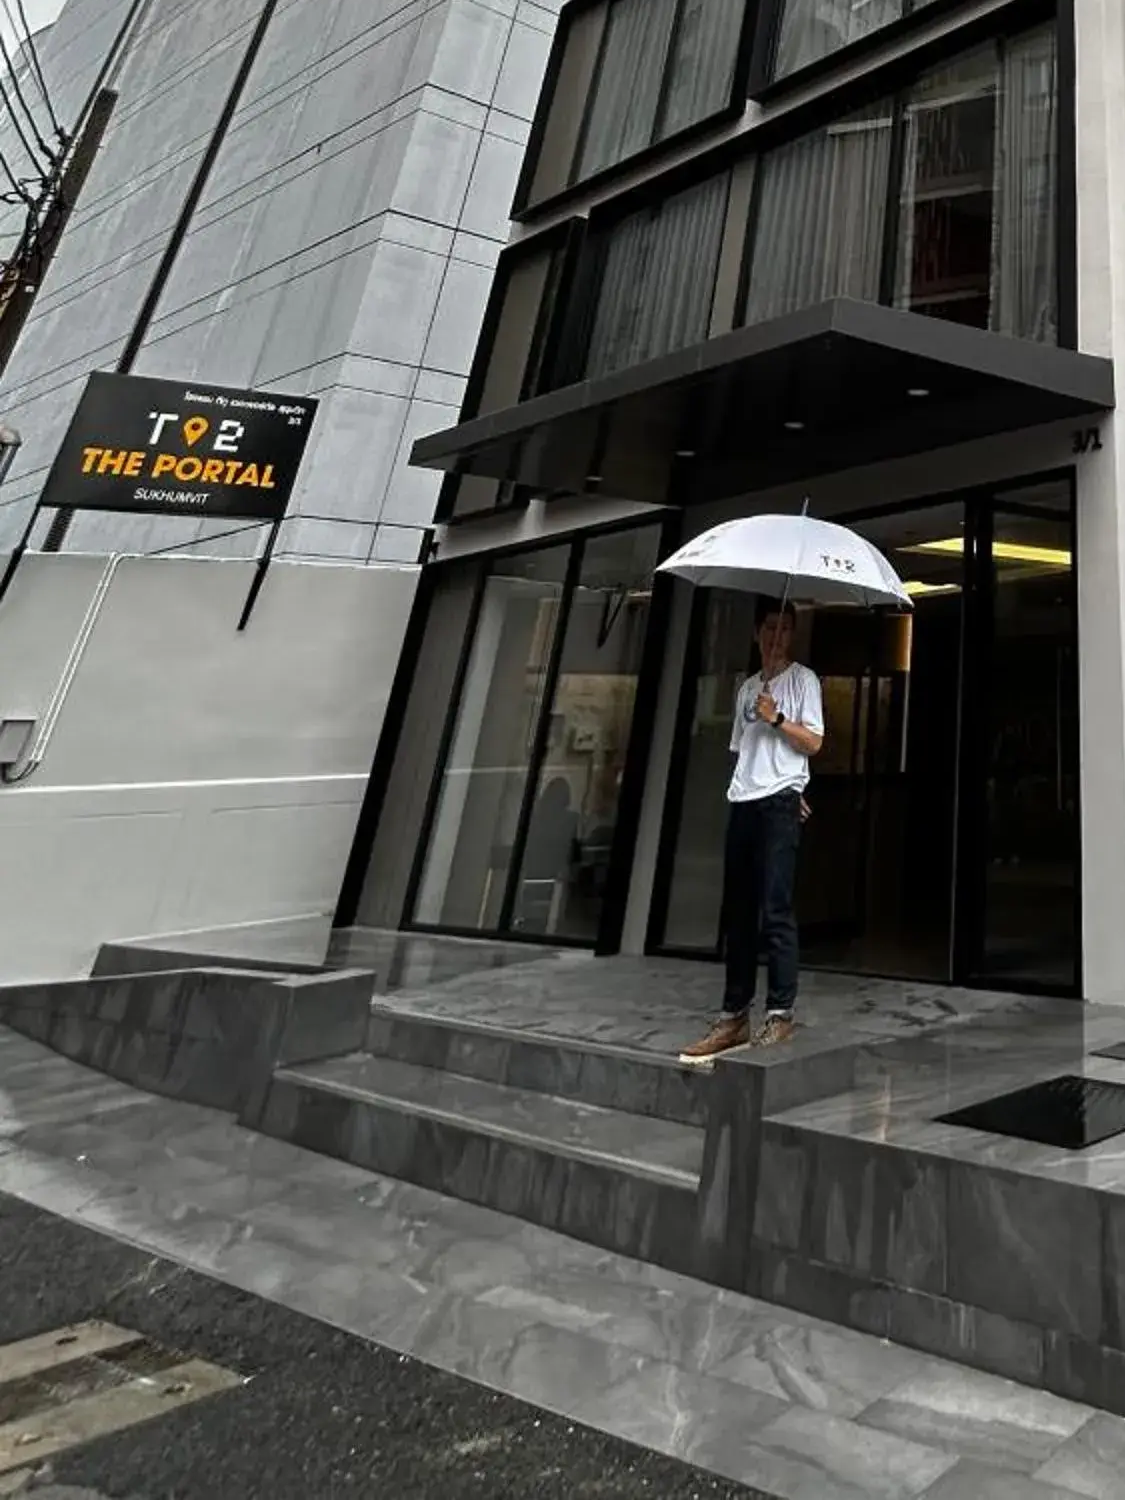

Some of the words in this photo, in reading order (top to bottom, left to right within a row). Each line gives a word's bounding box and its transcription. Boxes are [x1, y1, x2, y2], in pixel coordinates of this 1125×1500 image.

[81, 447, 146, 477] THE
[151, 454, 276, 488] PORTAL
[133, 486, 211, 505] SUKHUMVIT
